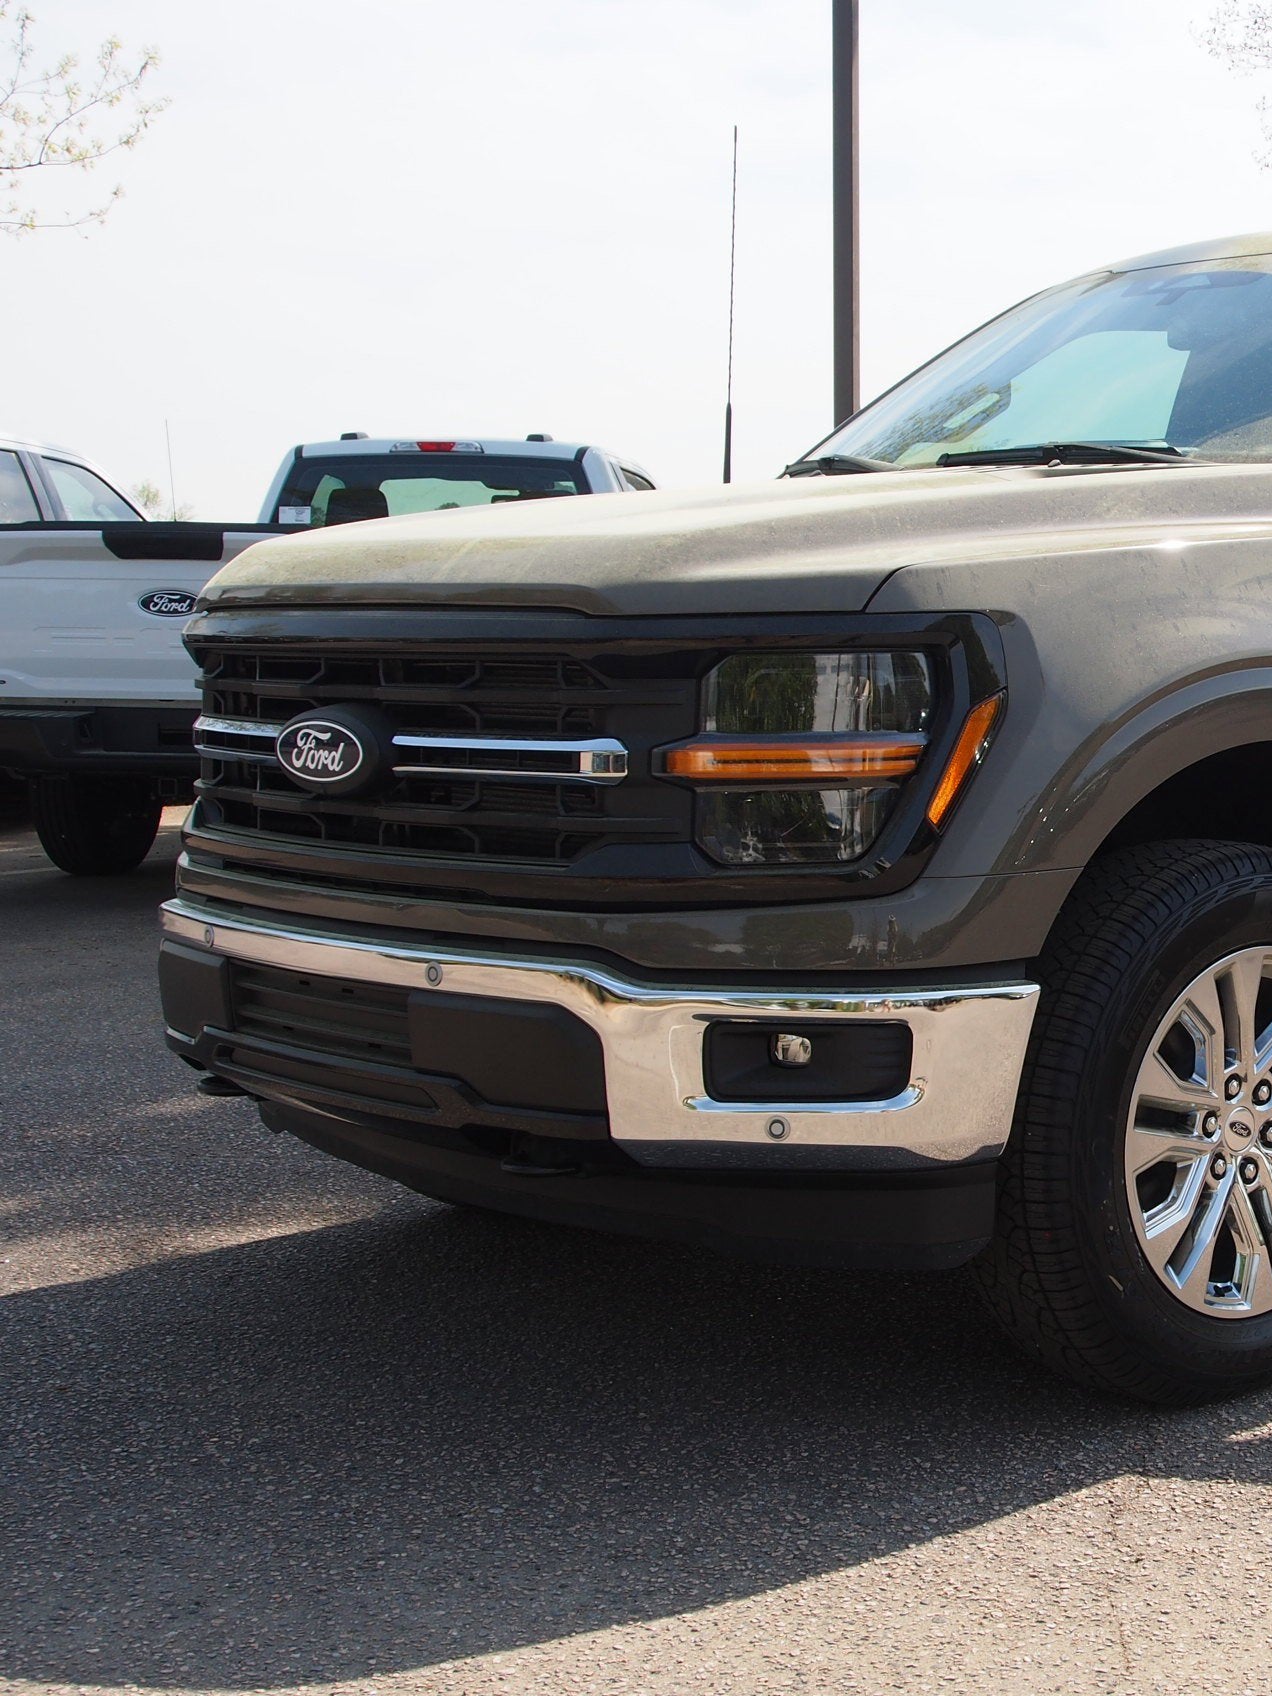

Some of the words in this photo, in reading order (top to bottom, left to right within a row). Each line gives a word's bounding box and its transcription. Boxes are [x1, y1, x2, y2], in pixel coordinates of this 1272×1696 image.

[150, 594, 191, 613] Ford
[291, 728, 345, 772] Ford
[1233, 1122, 1249, 1136] Ford
